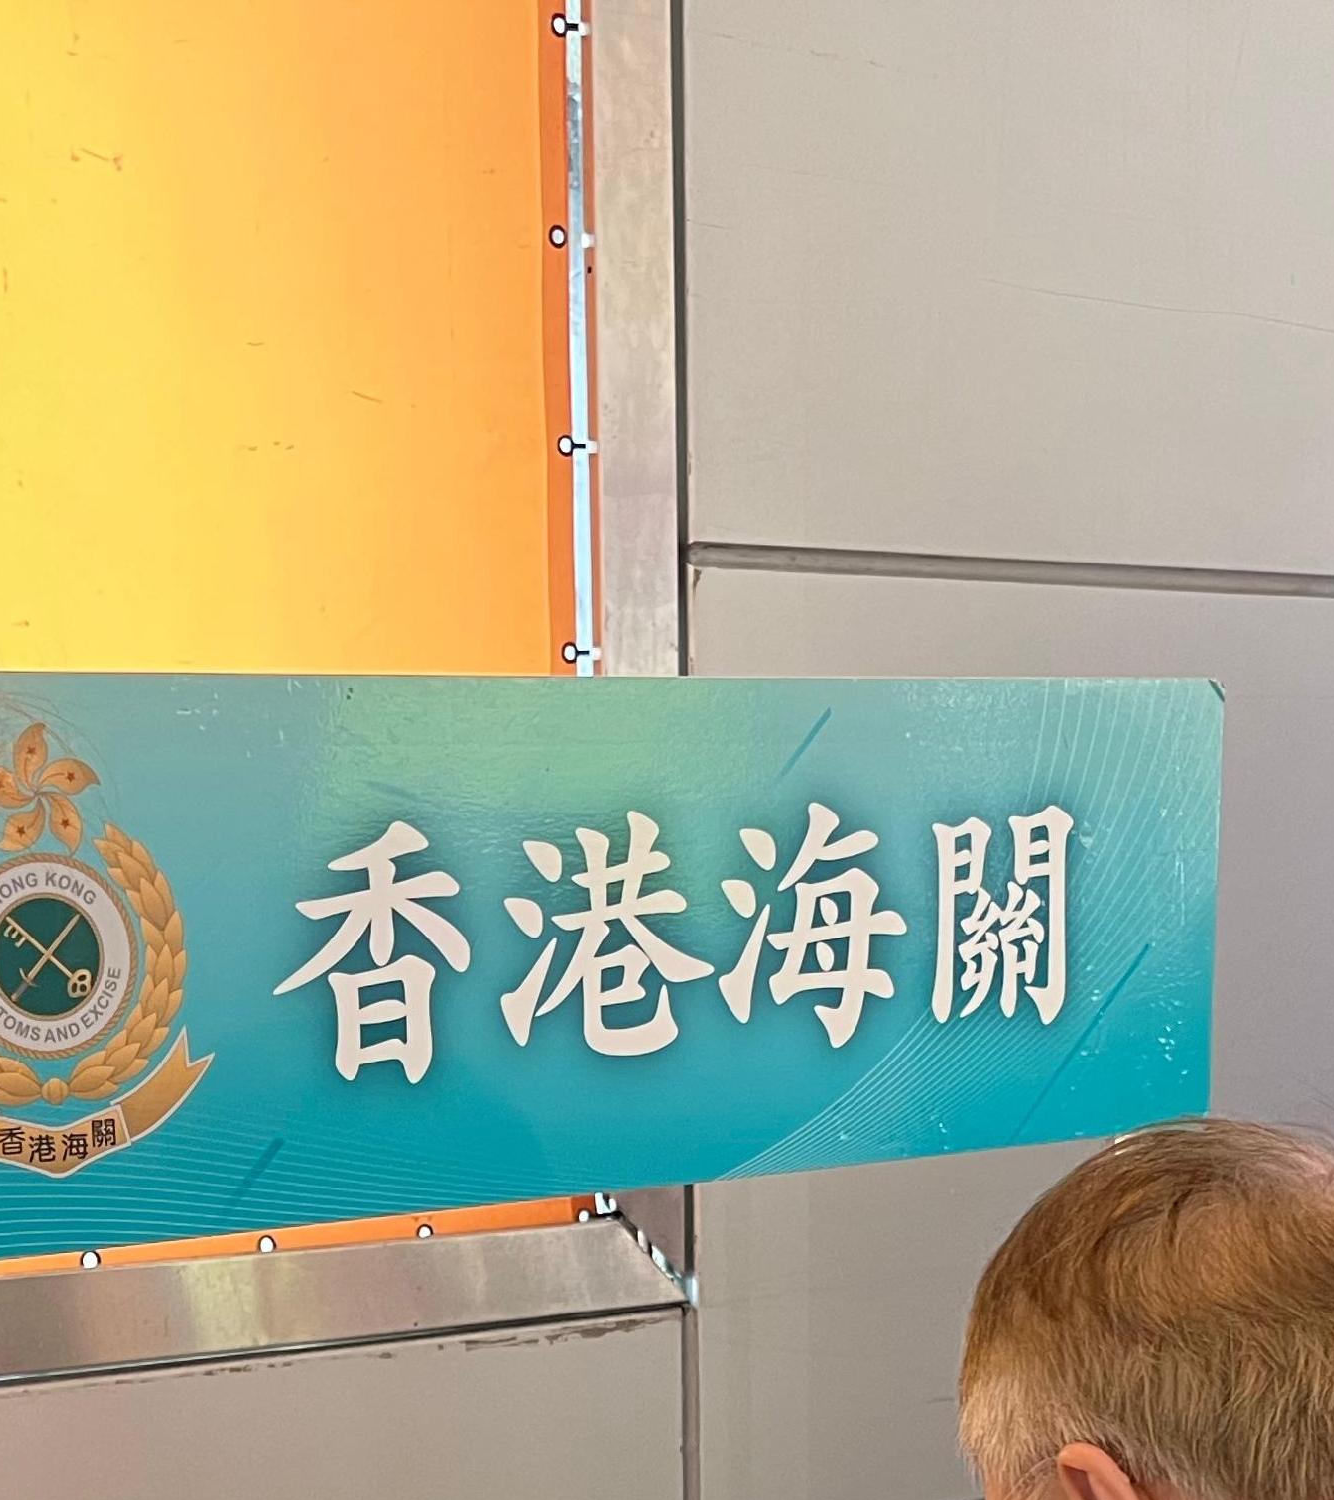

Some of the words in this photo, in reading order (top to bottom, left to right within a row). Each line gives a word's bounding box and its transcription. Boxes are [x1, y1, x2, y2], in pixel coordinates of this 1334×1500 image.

[45, 871, 97, 905] KONG
[273, 801, 1075, 1085] 香港海關
[44, 1022, 80, 1043] AND
[80, 966, 121, 1029] EXCISE
